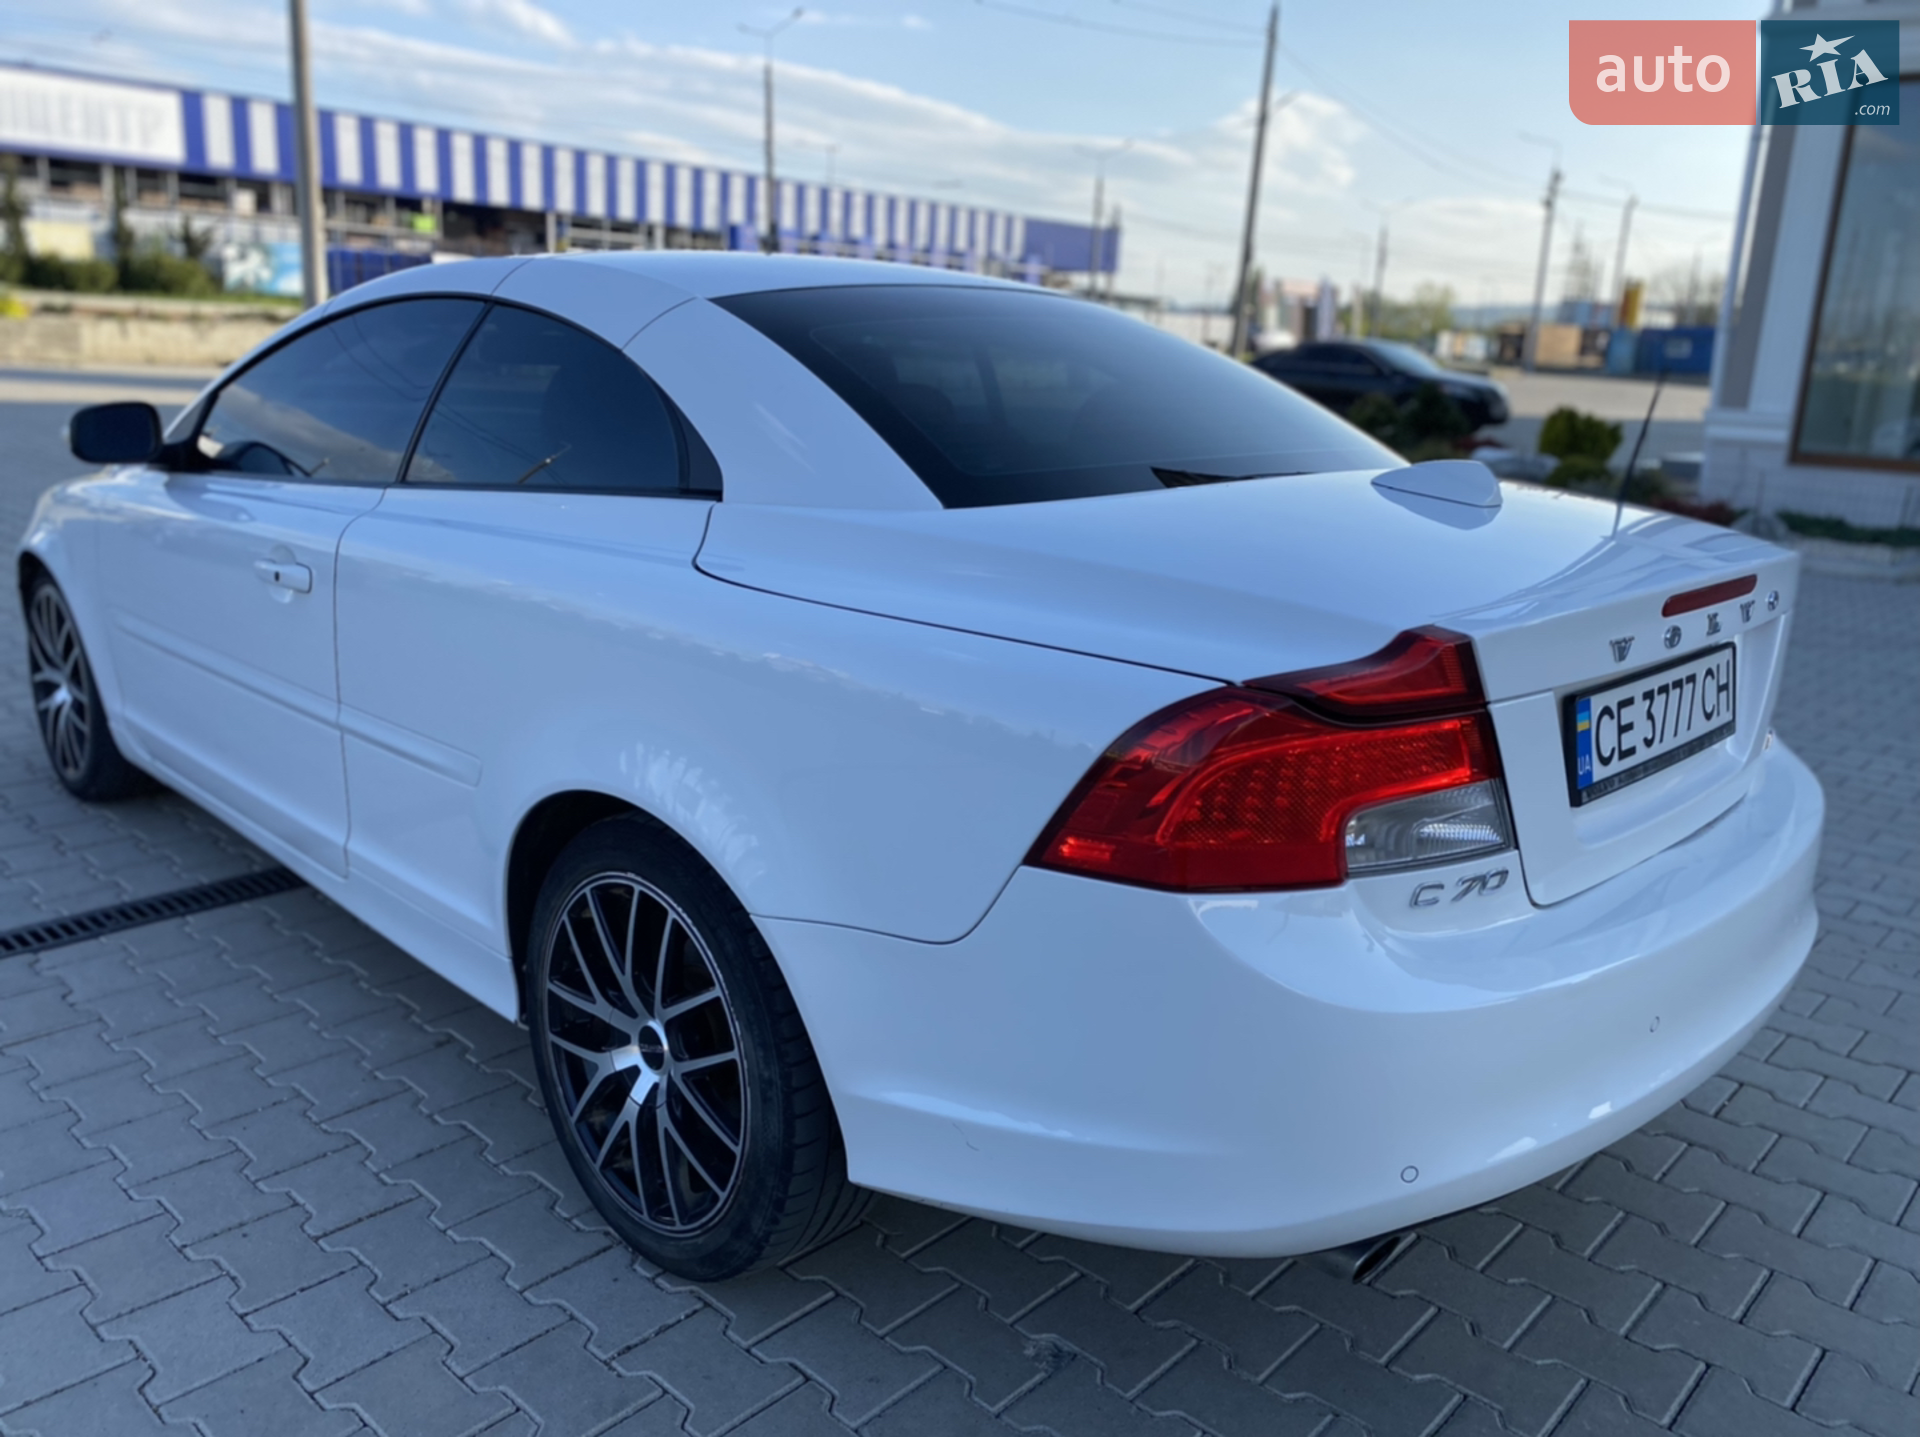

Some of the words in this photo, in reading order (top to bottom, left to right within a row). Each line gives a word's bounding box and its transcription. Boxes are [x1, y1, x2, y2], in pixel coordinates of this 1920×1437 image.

[1609, 589, 1780, 664] VOLVO
[1595, 696, 1637, 767] CE
[1642, 672, 1697, 749] 3777
[1701, 659, 1731, 722] CH
[1577, 755, 1592, 776] UA
[1409, 881, 1445, 909] C
[1449, 867, 1510, 903] 70
